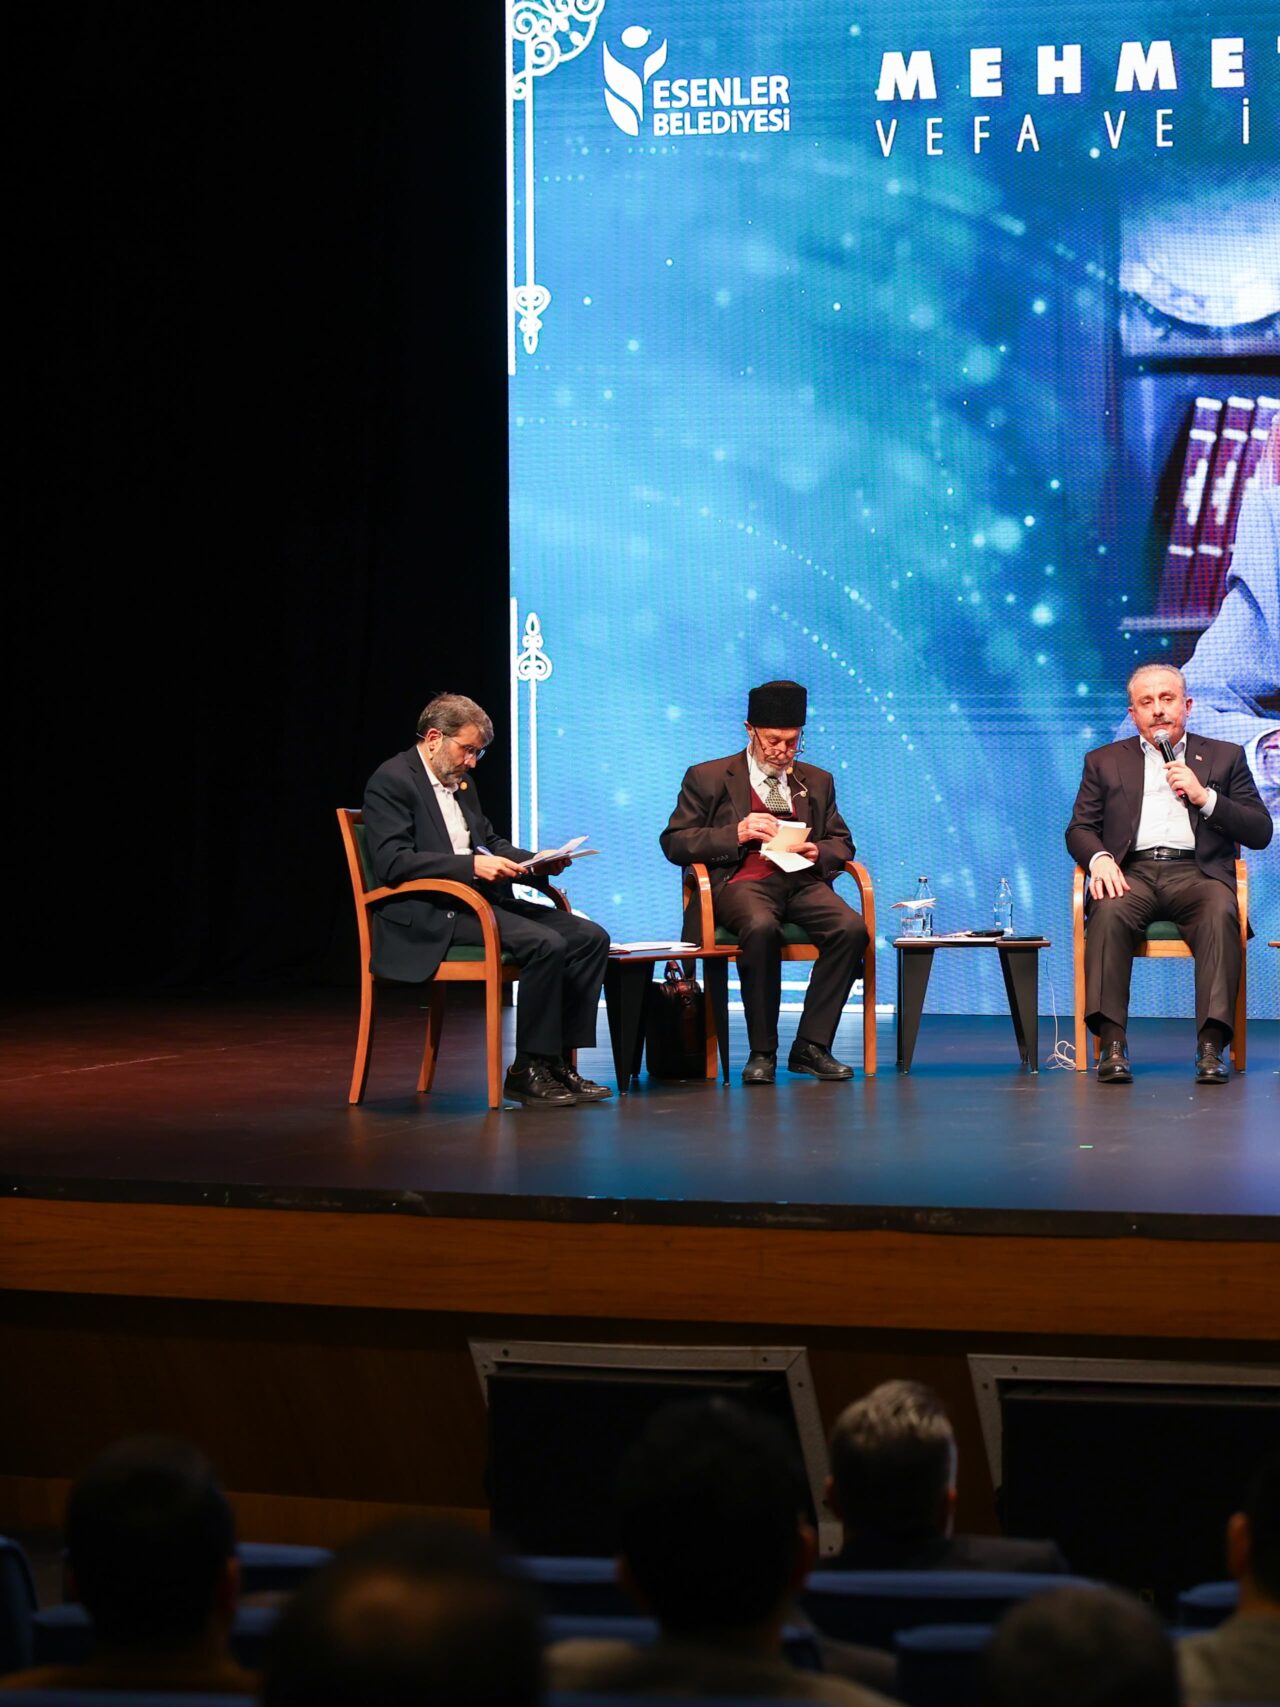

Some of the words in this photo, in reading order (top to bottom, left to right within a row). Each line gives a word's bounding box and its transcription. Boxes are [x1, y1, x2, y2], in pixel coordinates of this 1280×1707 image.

[653, 75, 790, 110] ESENLER
[653, 109, 791, 138] BELEDİYESİ
[875, 114, 1040, 157] VEFA
[1104, 109, 1174, 149] VE
